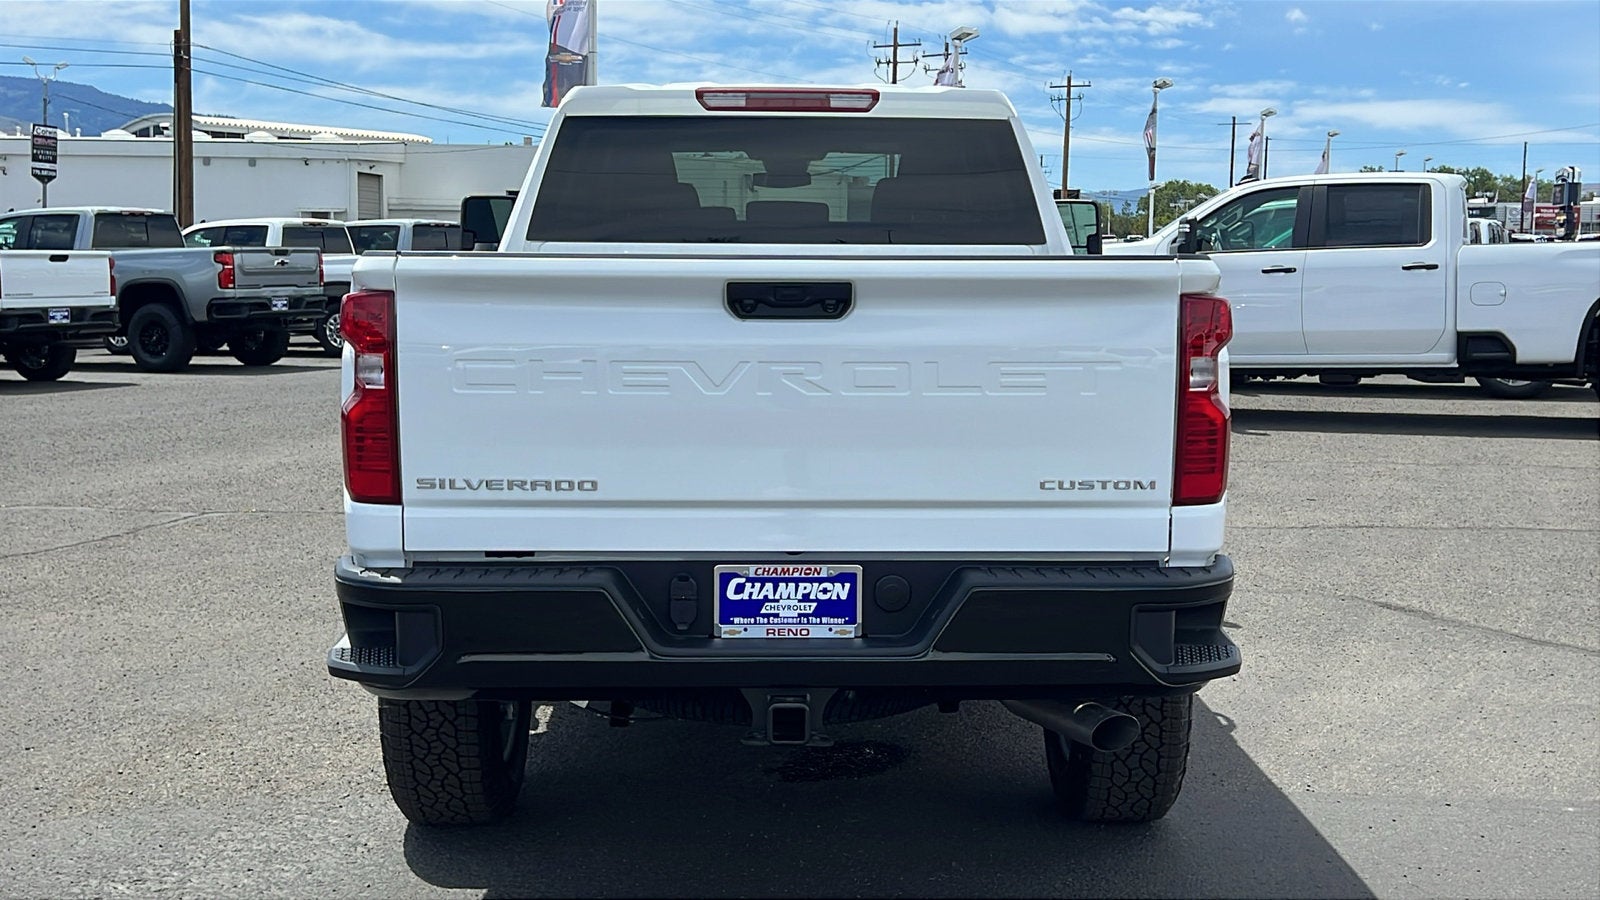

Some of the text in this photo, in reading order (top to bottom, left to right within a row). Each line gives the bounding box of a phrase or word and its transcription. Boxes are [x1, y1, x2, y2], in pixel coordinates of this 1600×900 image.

[452, 358, 1124, 397] CHEVROLET
[415, 477, 599, 492] SILVERADO
[1039, 479, 1157, 491] CUSTOM
[754, 566, 823, 577] CHAMPION
[725, 577, 851, 601] CHAMPION
[764, 604, 814, 612] CHEVROLET
[756, 617, 768, 625] The
[769, 617, 800, 625] Customer
[809, 617, 821, 625] The
[765, 627, 811, 637] RENO
